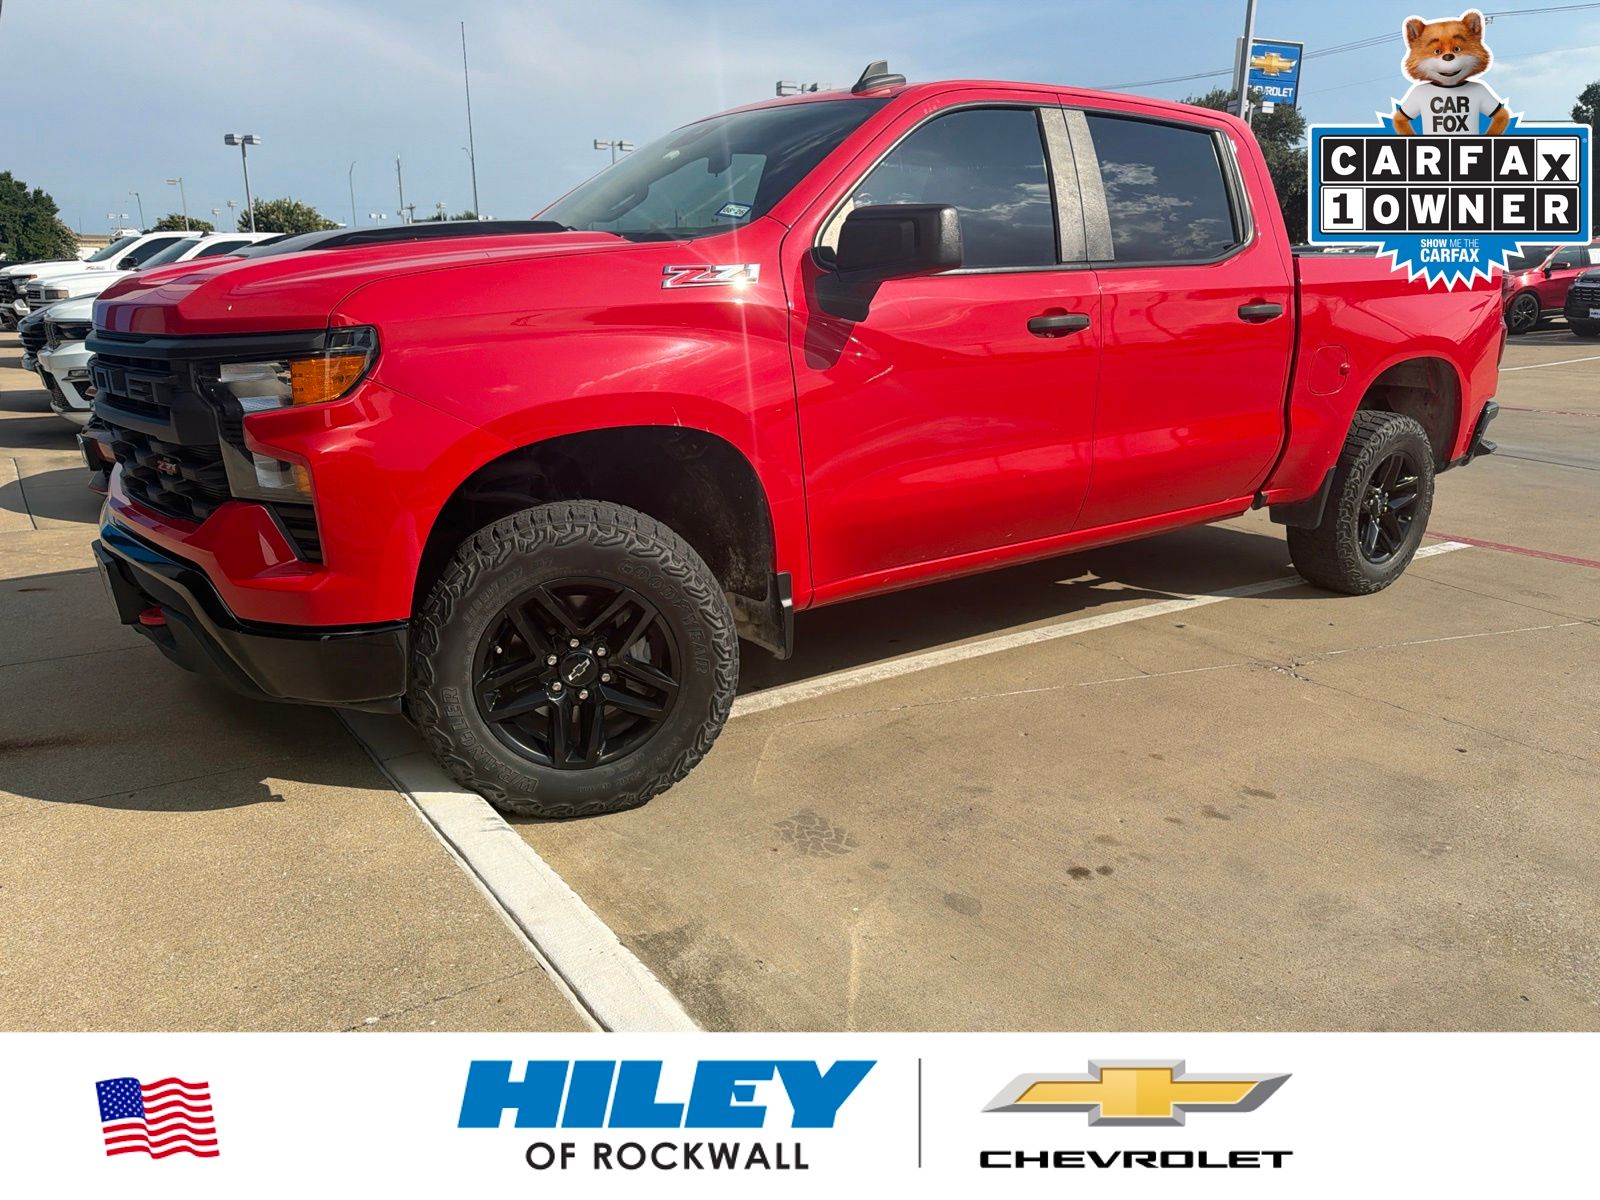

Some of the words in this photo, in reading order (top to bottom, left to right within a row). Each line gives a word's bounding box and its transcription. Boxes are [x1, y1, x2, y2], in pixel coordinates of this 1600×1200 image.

[1248, 84, 1293, 97] EVROLET
[618, 560, 711, 675] GOODYEAR
[443, 687, 539, 793] WRANGLER
